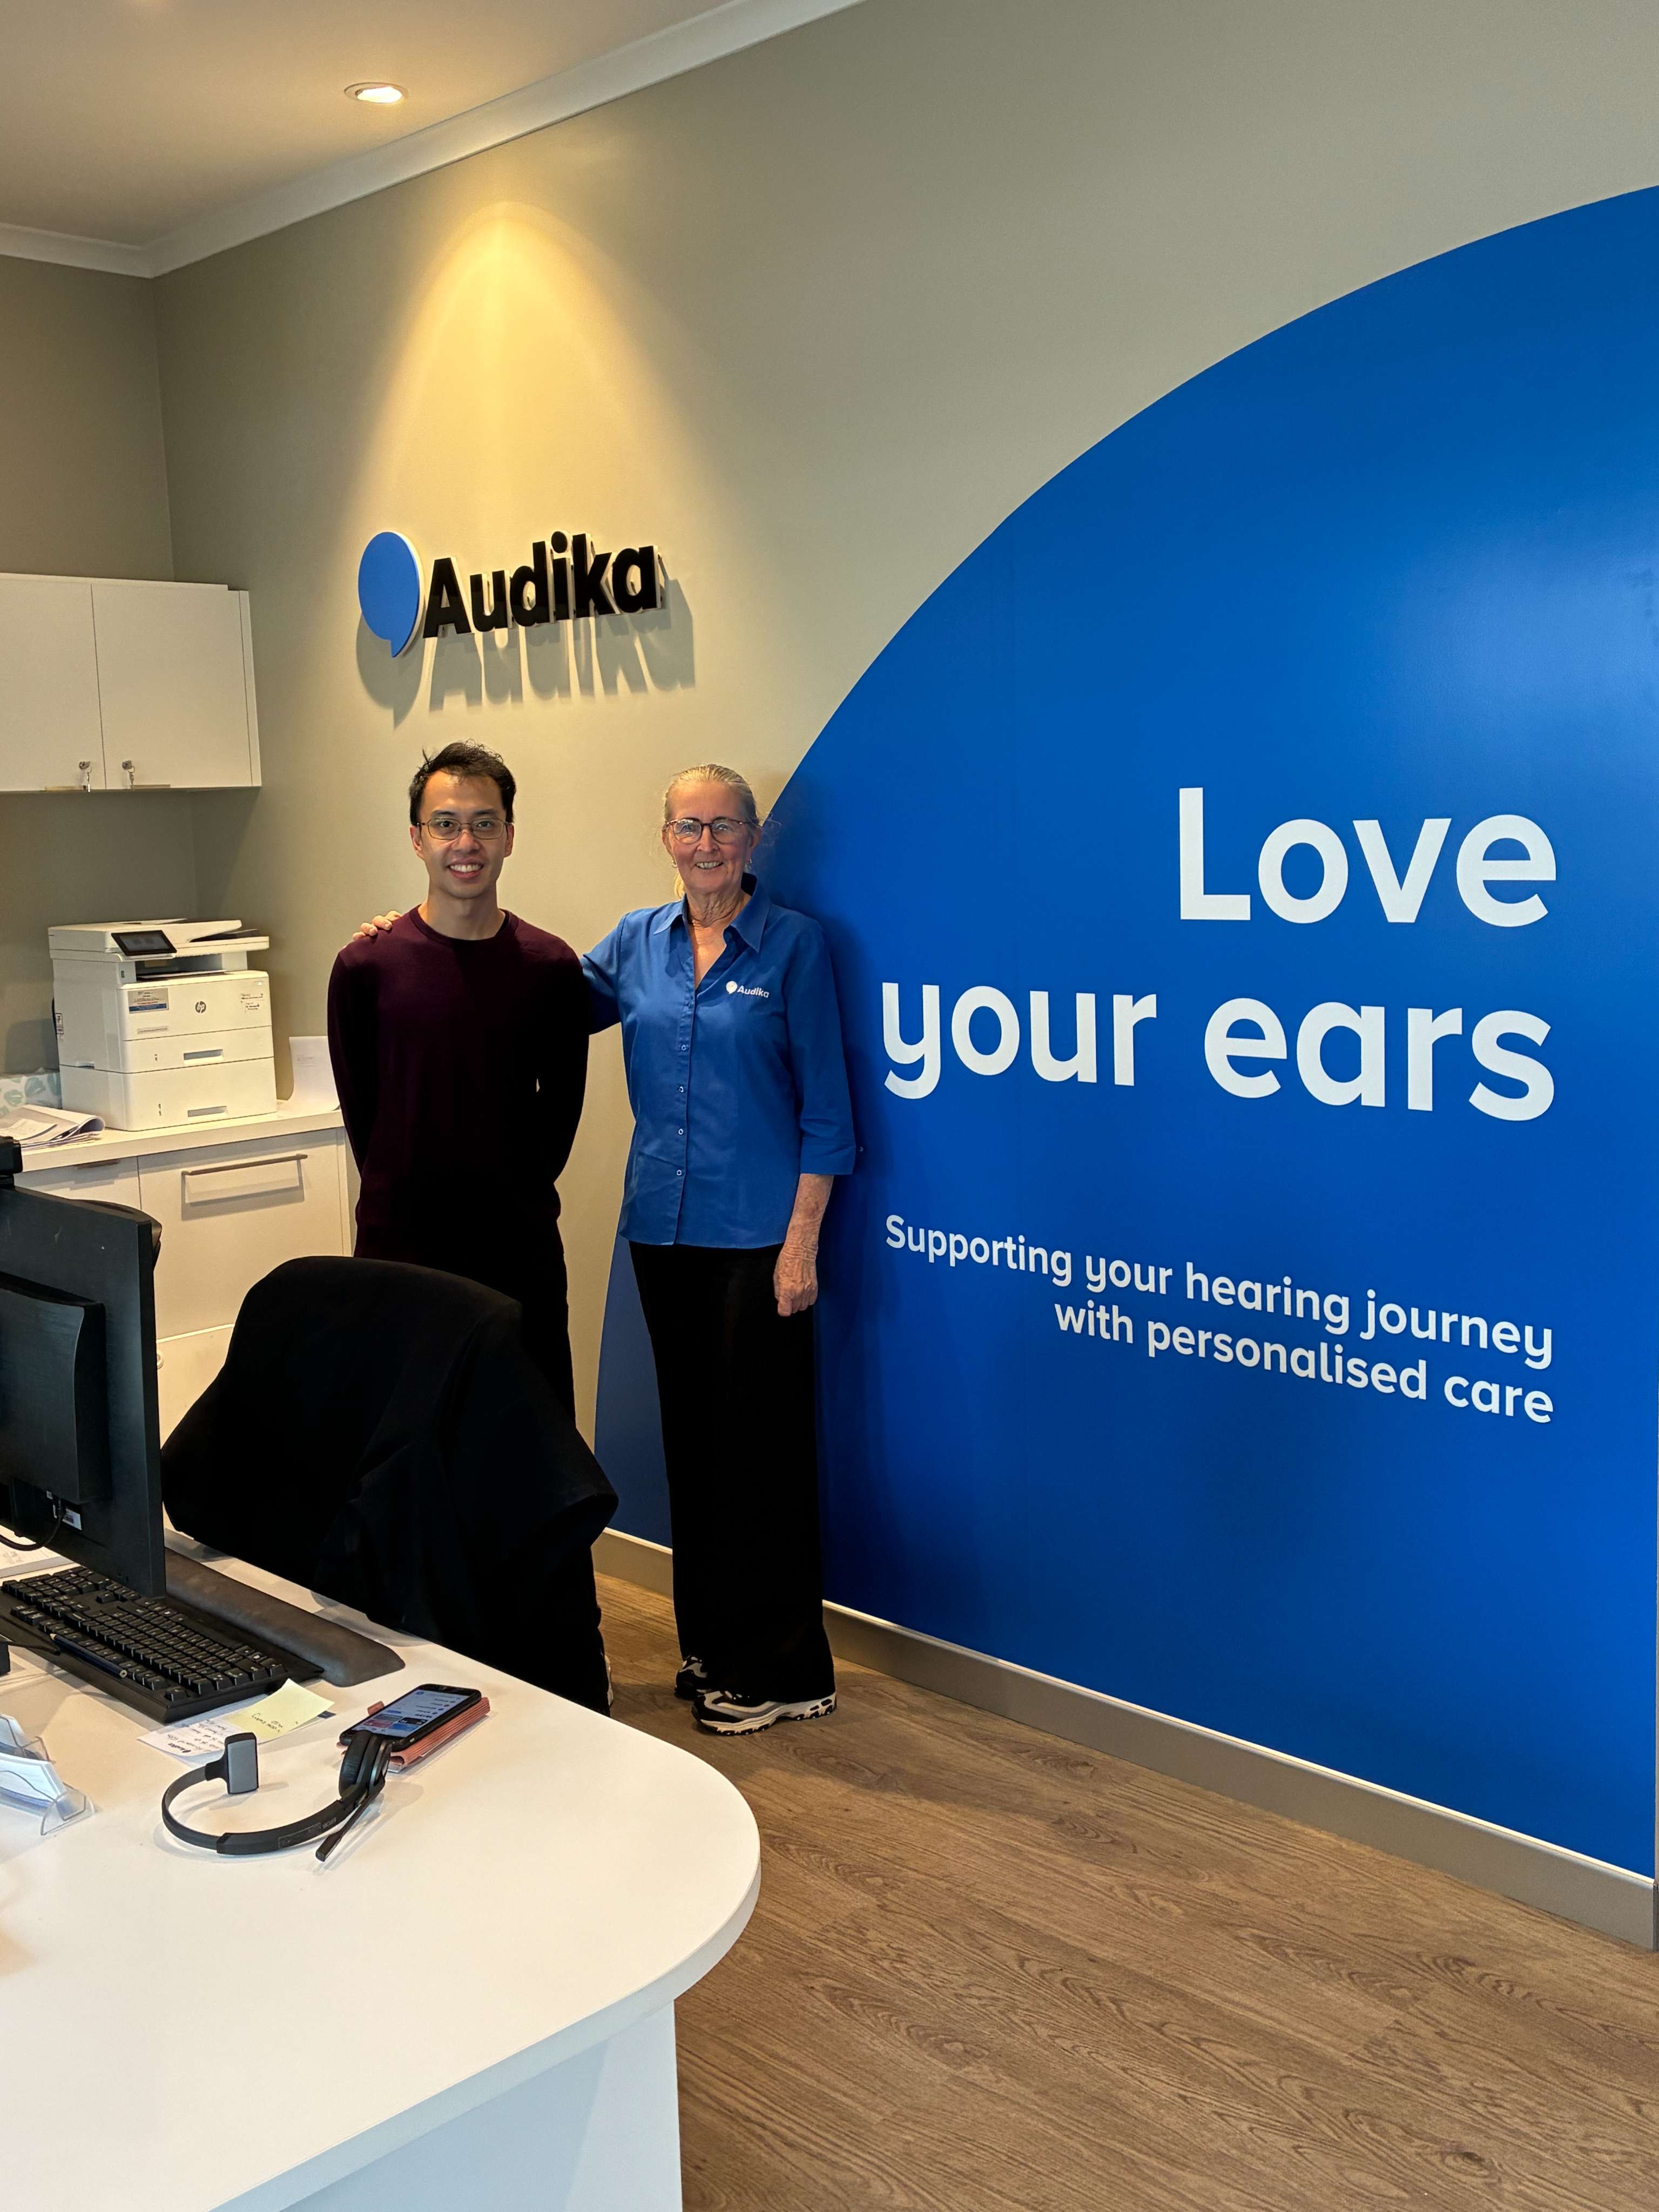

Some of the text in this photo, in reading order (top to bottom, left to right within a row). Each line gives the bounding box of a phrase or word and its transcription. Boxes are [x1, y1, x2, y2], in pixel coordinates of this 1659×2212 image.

[423, 531, 657, 639] Audika
[1178, 787, 1557, 927] Love
[196, 1001, 206, 1014] hp
[737, 985, 769, 998] Audika
[881, 982, 1555, 1122] your ears
[886, 1215, 1553, 1370] Supporting your hearing journey
[1054, 1303, 1553, 1423] with personalised care
